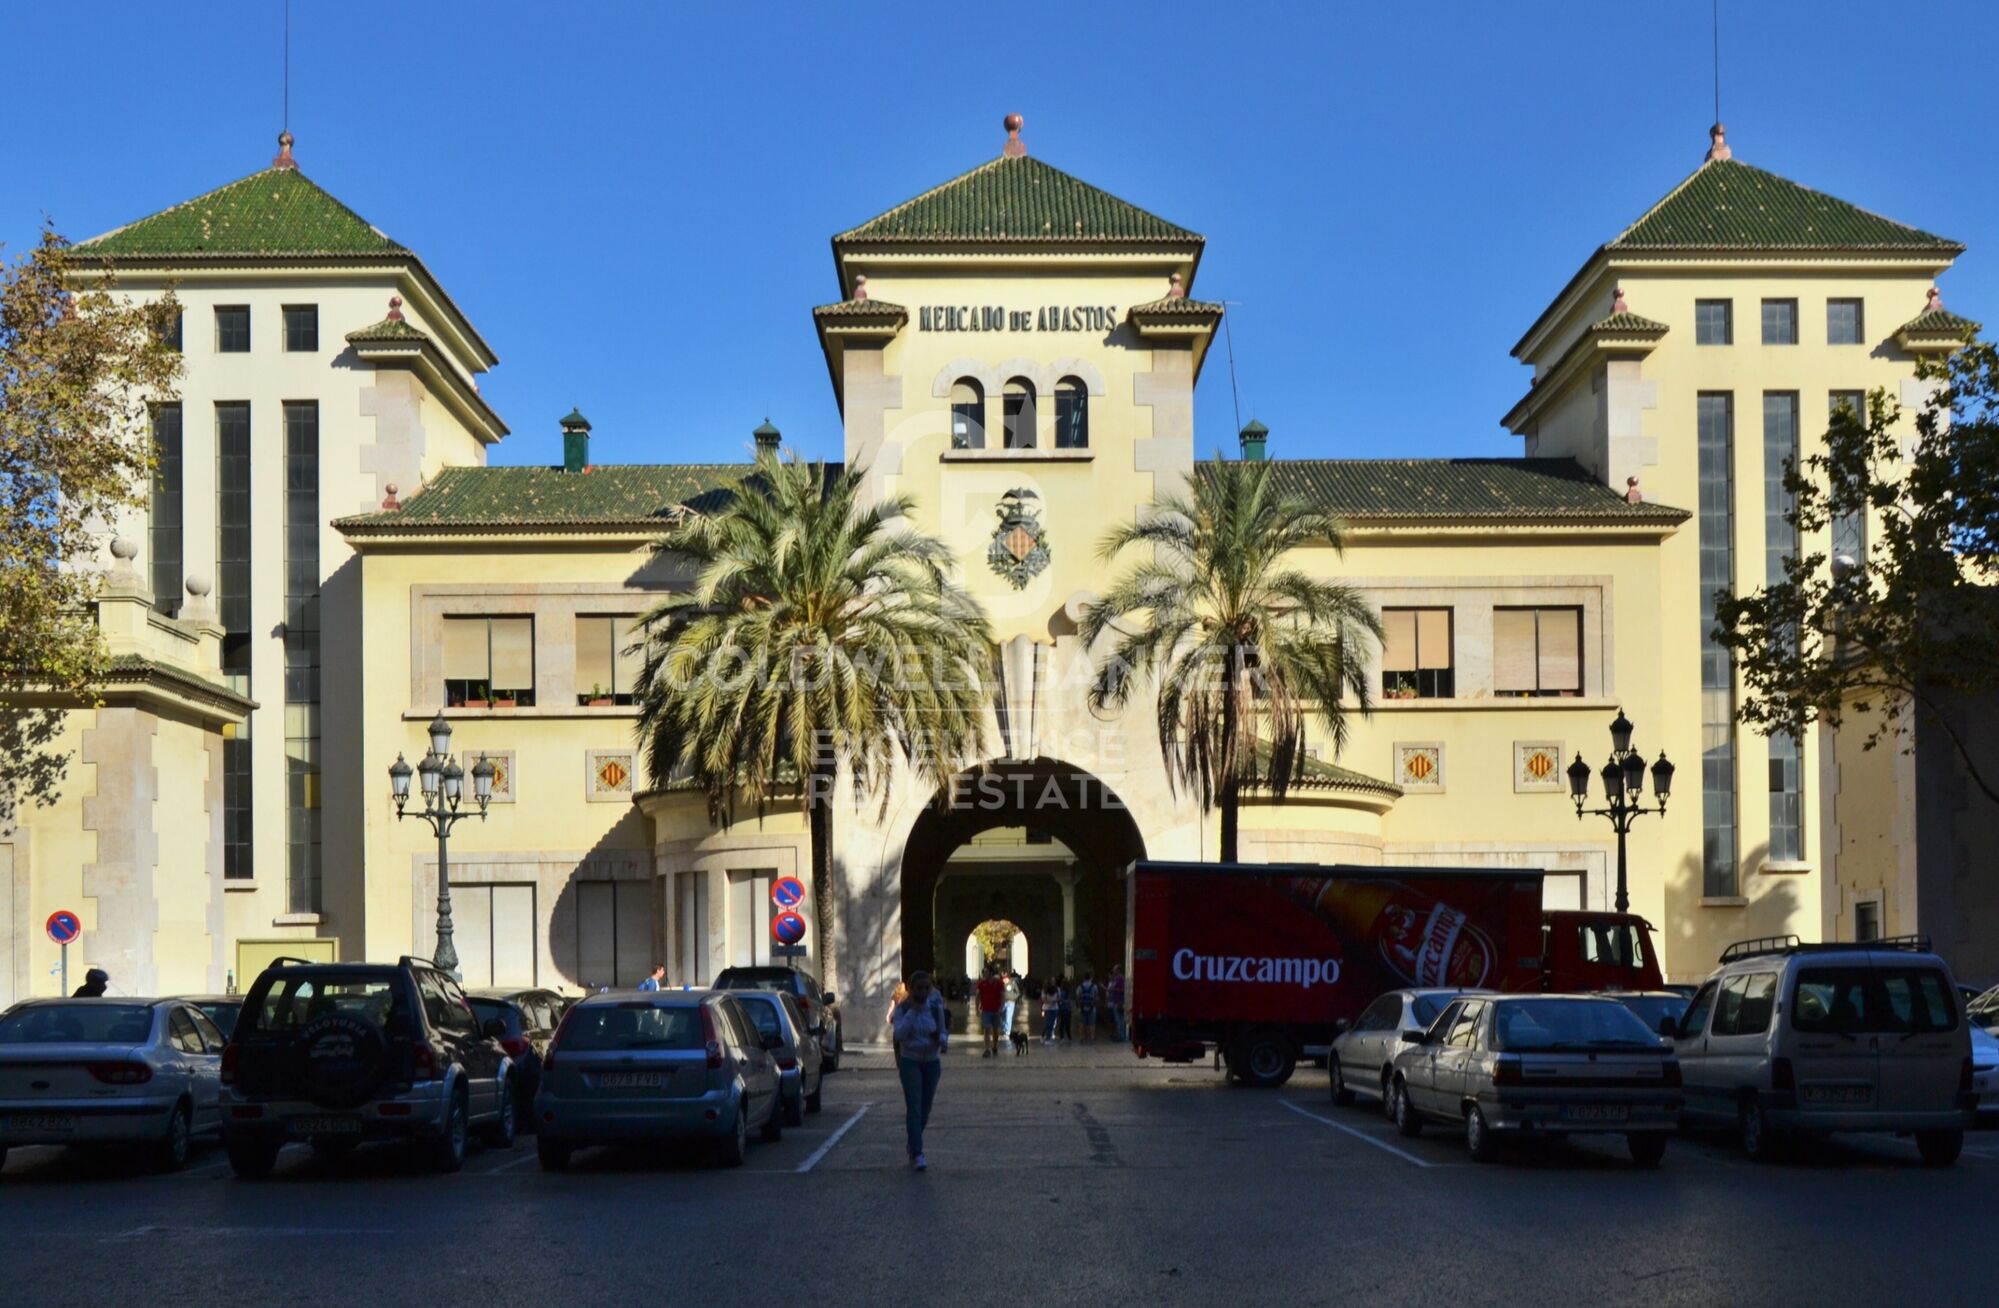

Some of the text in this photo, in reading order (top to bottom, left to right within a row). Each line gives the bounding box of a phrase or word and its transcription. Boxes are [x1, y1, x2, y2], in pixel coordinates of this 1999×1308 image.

[919, 306, 1005, 332] MERCADO
[1037, 305, 1117, 332] ABASTOS
[1172, 948, 1341, 989] Cruzcampo
